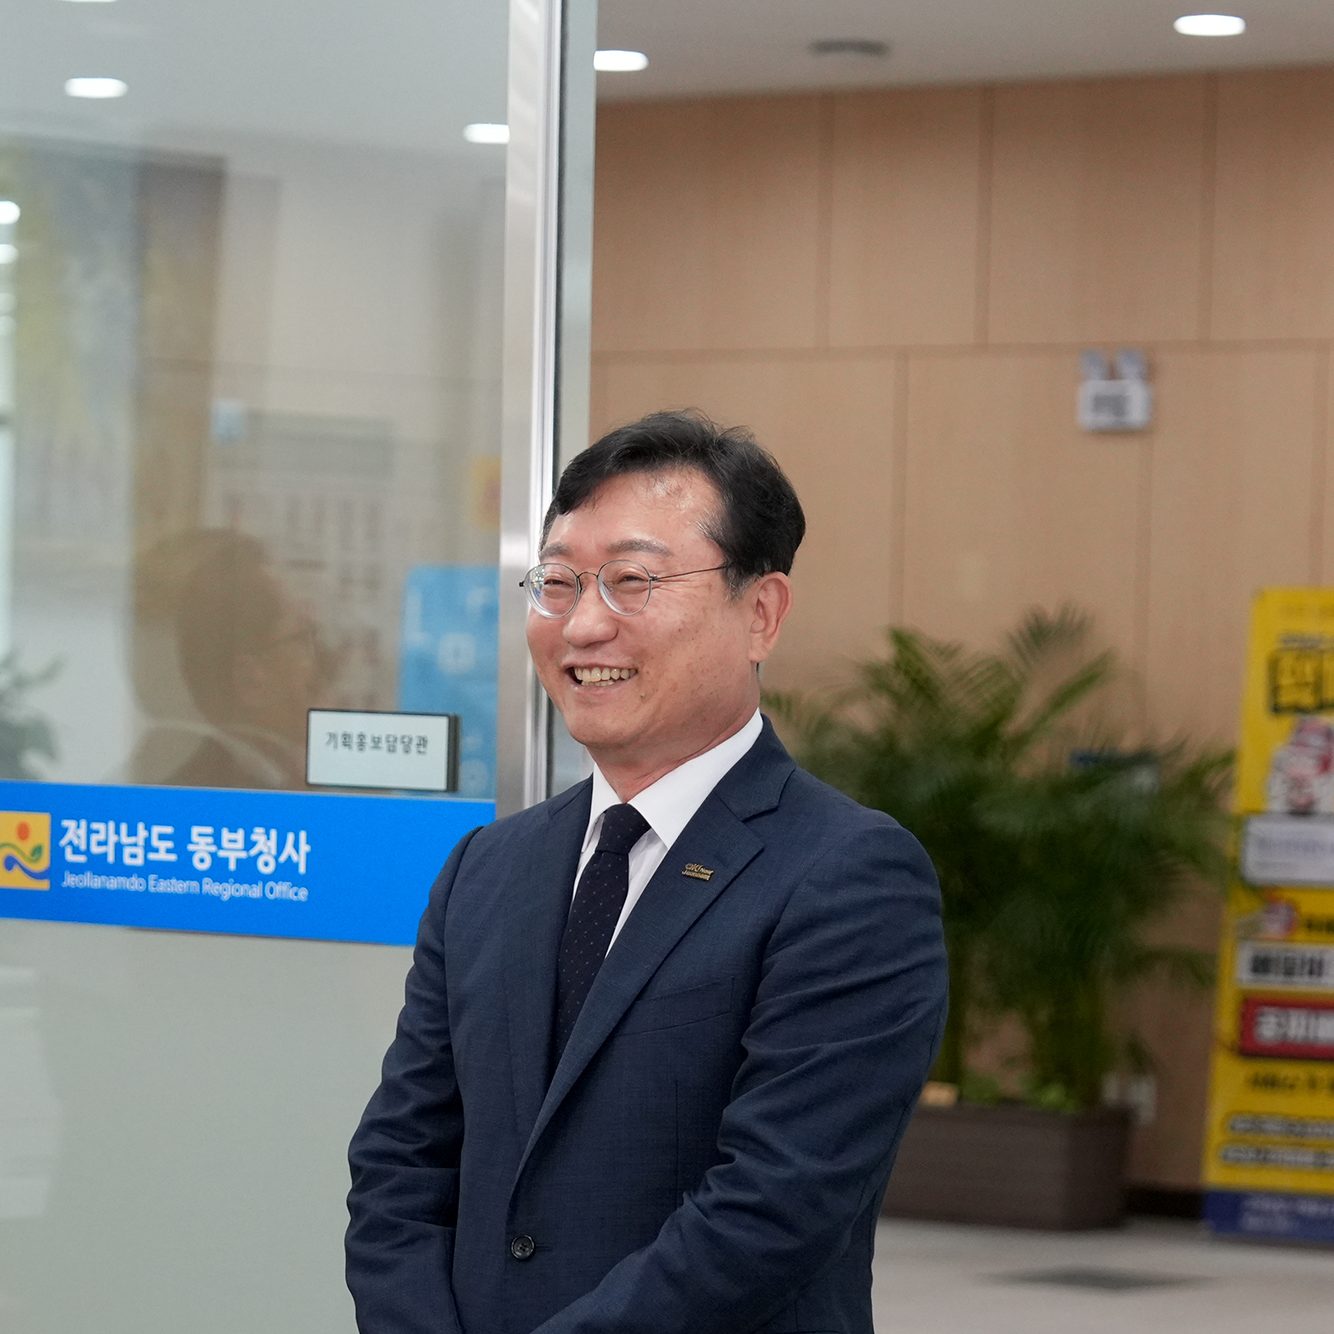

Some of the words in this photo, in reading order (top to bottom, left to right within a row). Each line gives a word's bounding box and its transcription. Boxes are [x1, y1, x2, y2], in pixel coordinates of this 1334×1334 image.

[326, 731, 428, 755] 기획홍보담당관
[59, 819, 178, 866] 전라남도
[187, 826, 311, 874] 동부청사
[61, 871, 146, 891] Jeollanamdo
[148, 875, 200, 894] Eastern
[202, 878, 263, 901] Regional
[265, 881, 308, 901] Office
